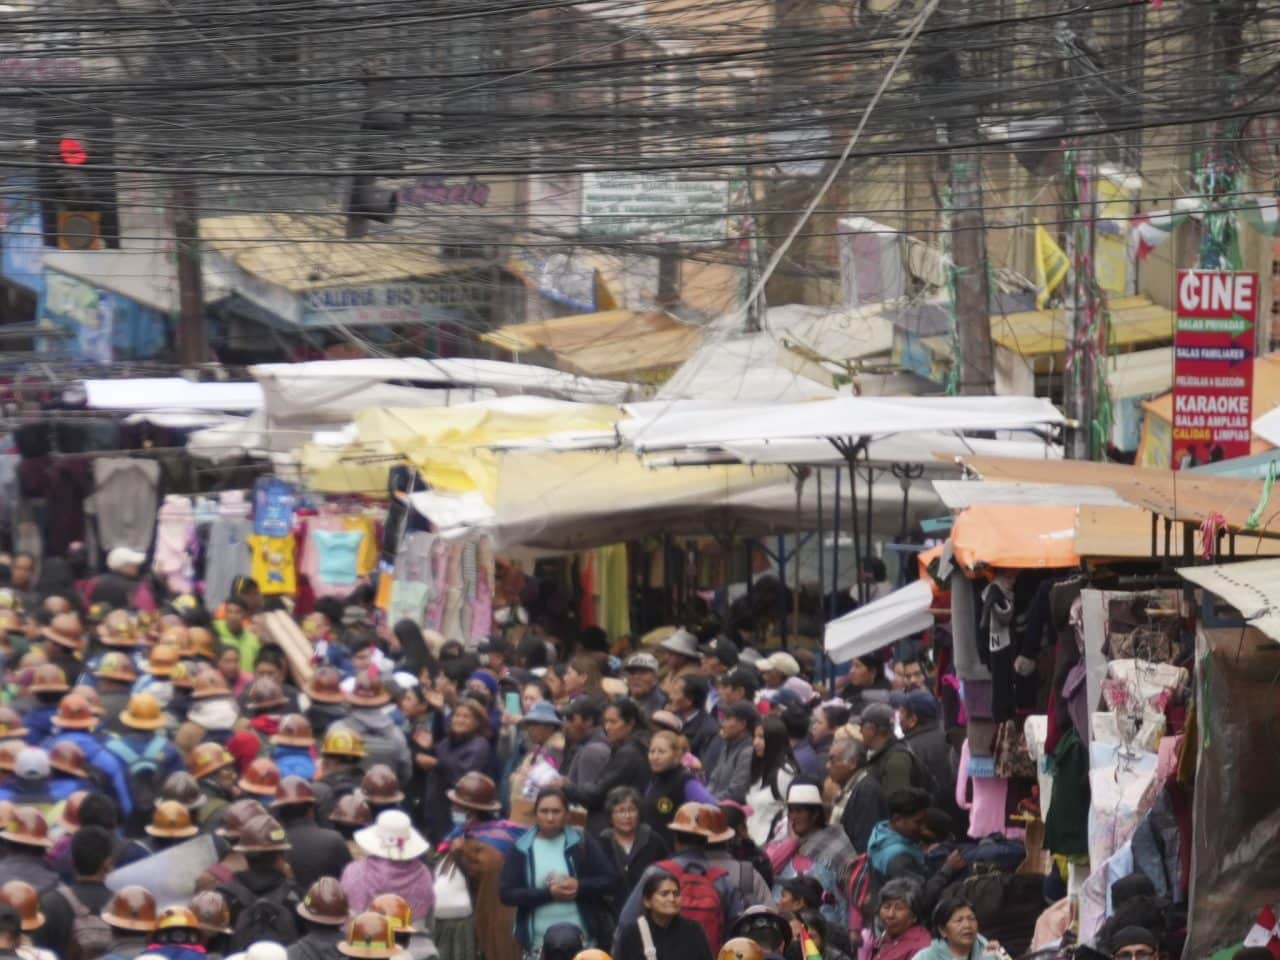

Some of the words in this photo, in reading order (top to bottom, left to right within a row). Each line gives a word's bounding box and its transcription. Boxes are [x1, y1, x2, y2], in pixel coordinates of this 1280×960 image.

[1180, 275, 1253, 311] CINE
[1178, 319, 1203, 330] SALAS
[1177, 348, 1199, 359] SALAS
[1201, 348, 1244, 360] FAMILIARES
[1176, 395, 1248, 413] KARAOKE
[1175, 414, 1204, 426] SALAS
[1207, 415, 1248, 427] AMPLIAS
[1214, 429, 1249, 441] LIMPIAS
